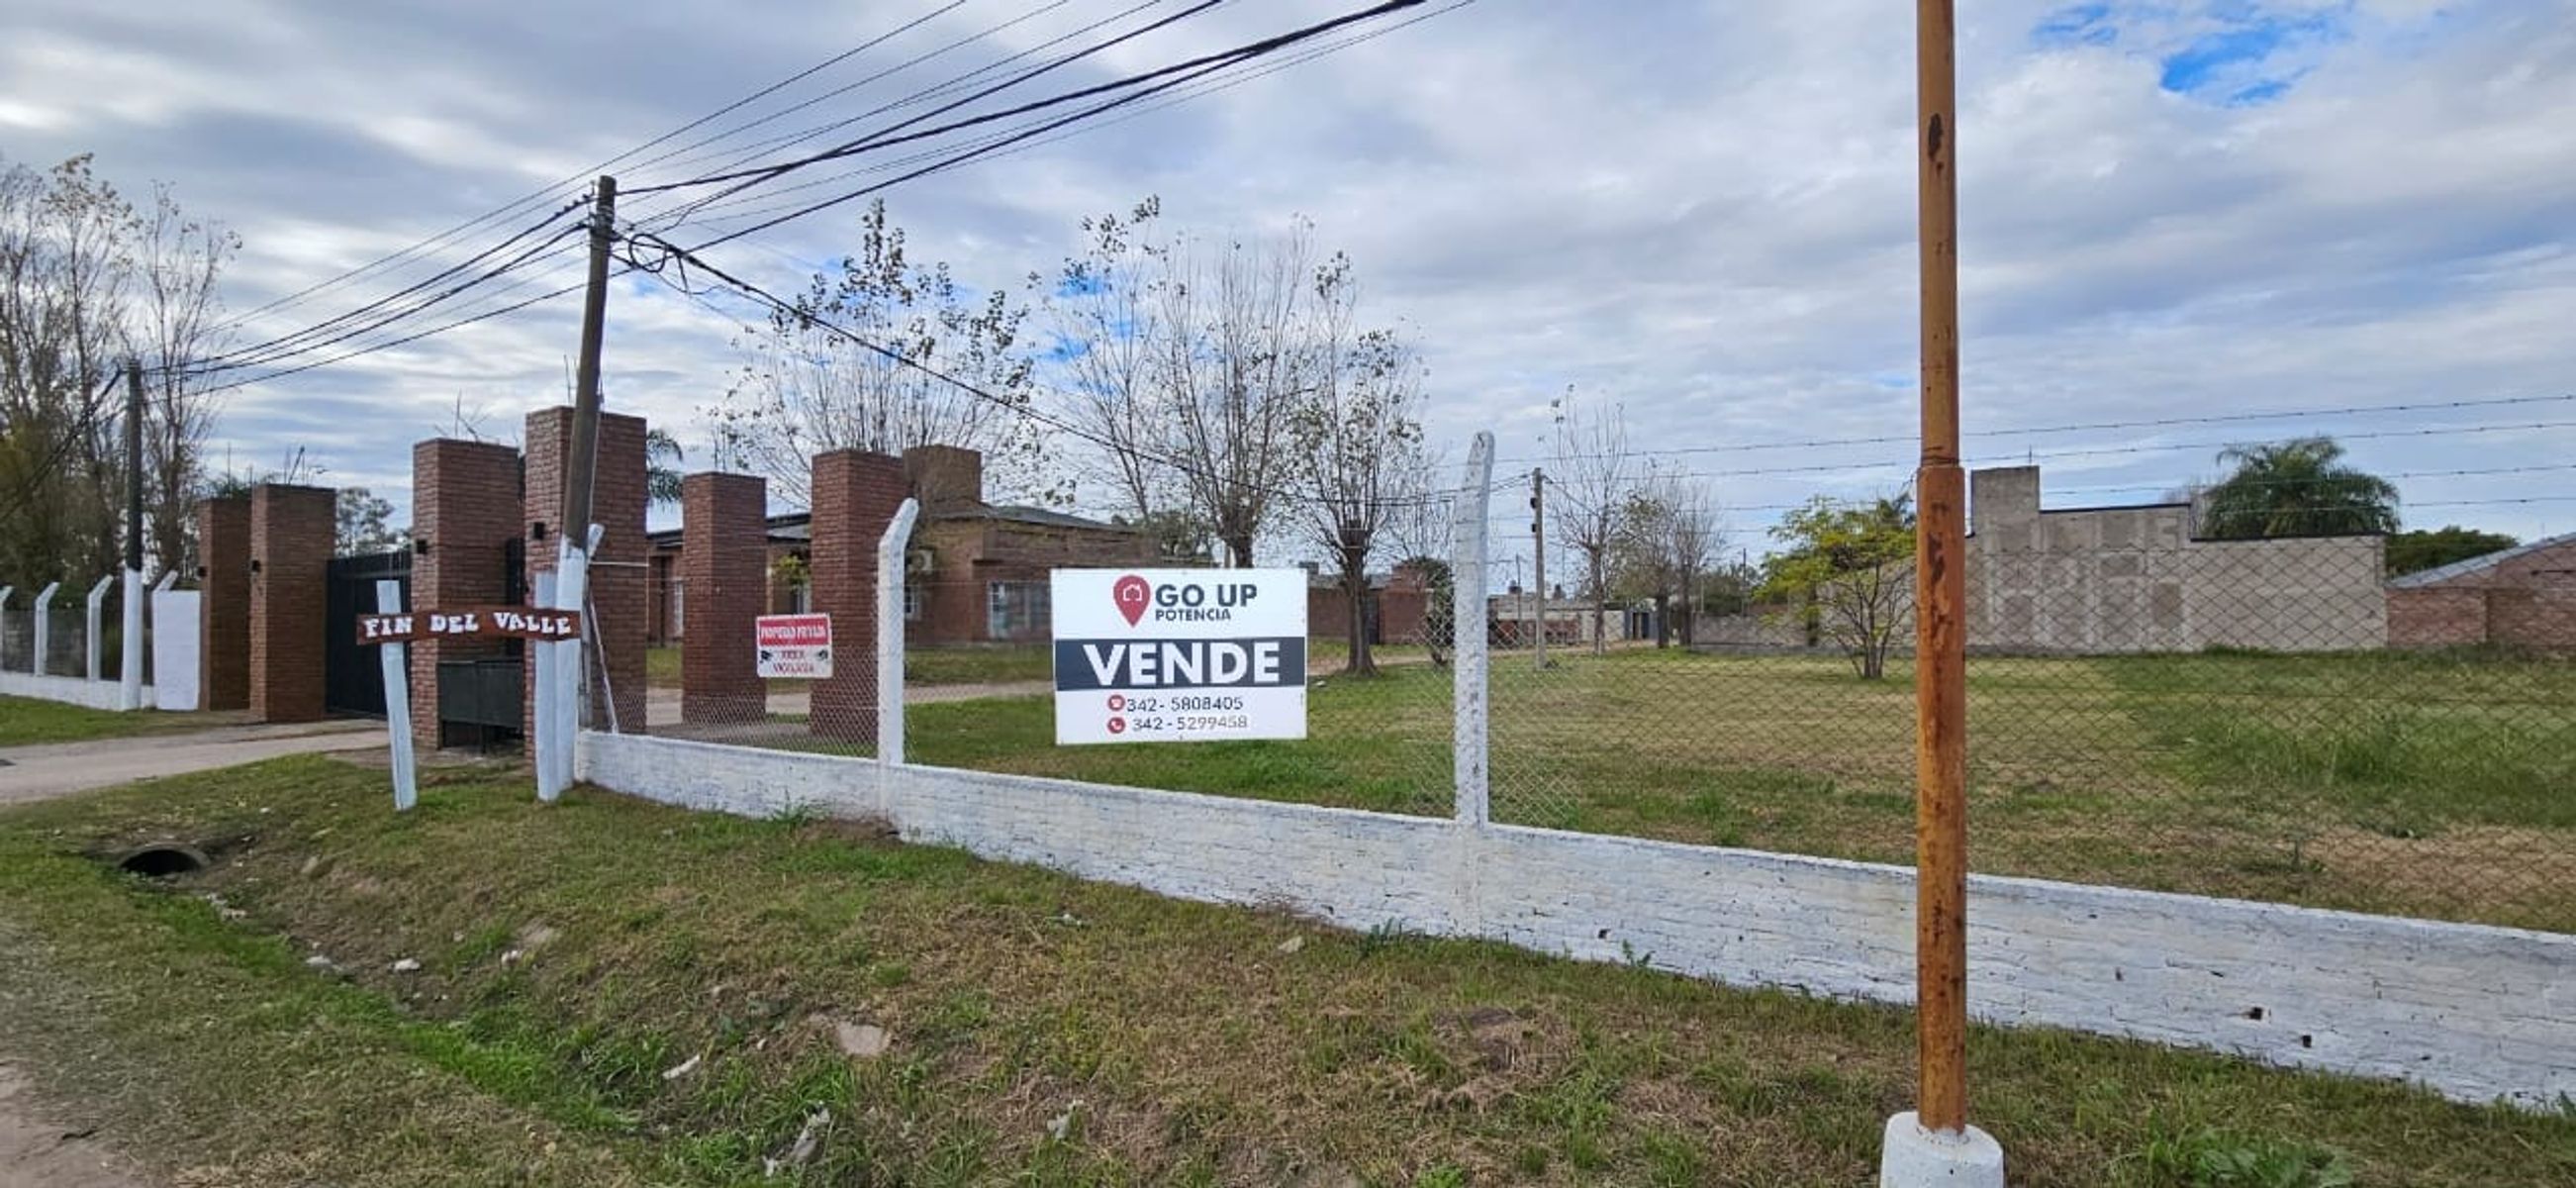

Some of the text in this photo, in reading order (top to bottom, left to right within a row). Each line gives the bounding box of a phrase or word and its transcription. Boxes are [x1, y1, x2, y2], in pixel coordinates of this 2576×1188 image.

[1155, 584, 1258, 608] GO UP
[363, 612, 572, 639] FIN DEL VALLE
[1155, 608, 1231, 622] POTENCIA
[1082, 641, 1281, 687] VENDE
[1177, 715, 1248, 731] 5299458
